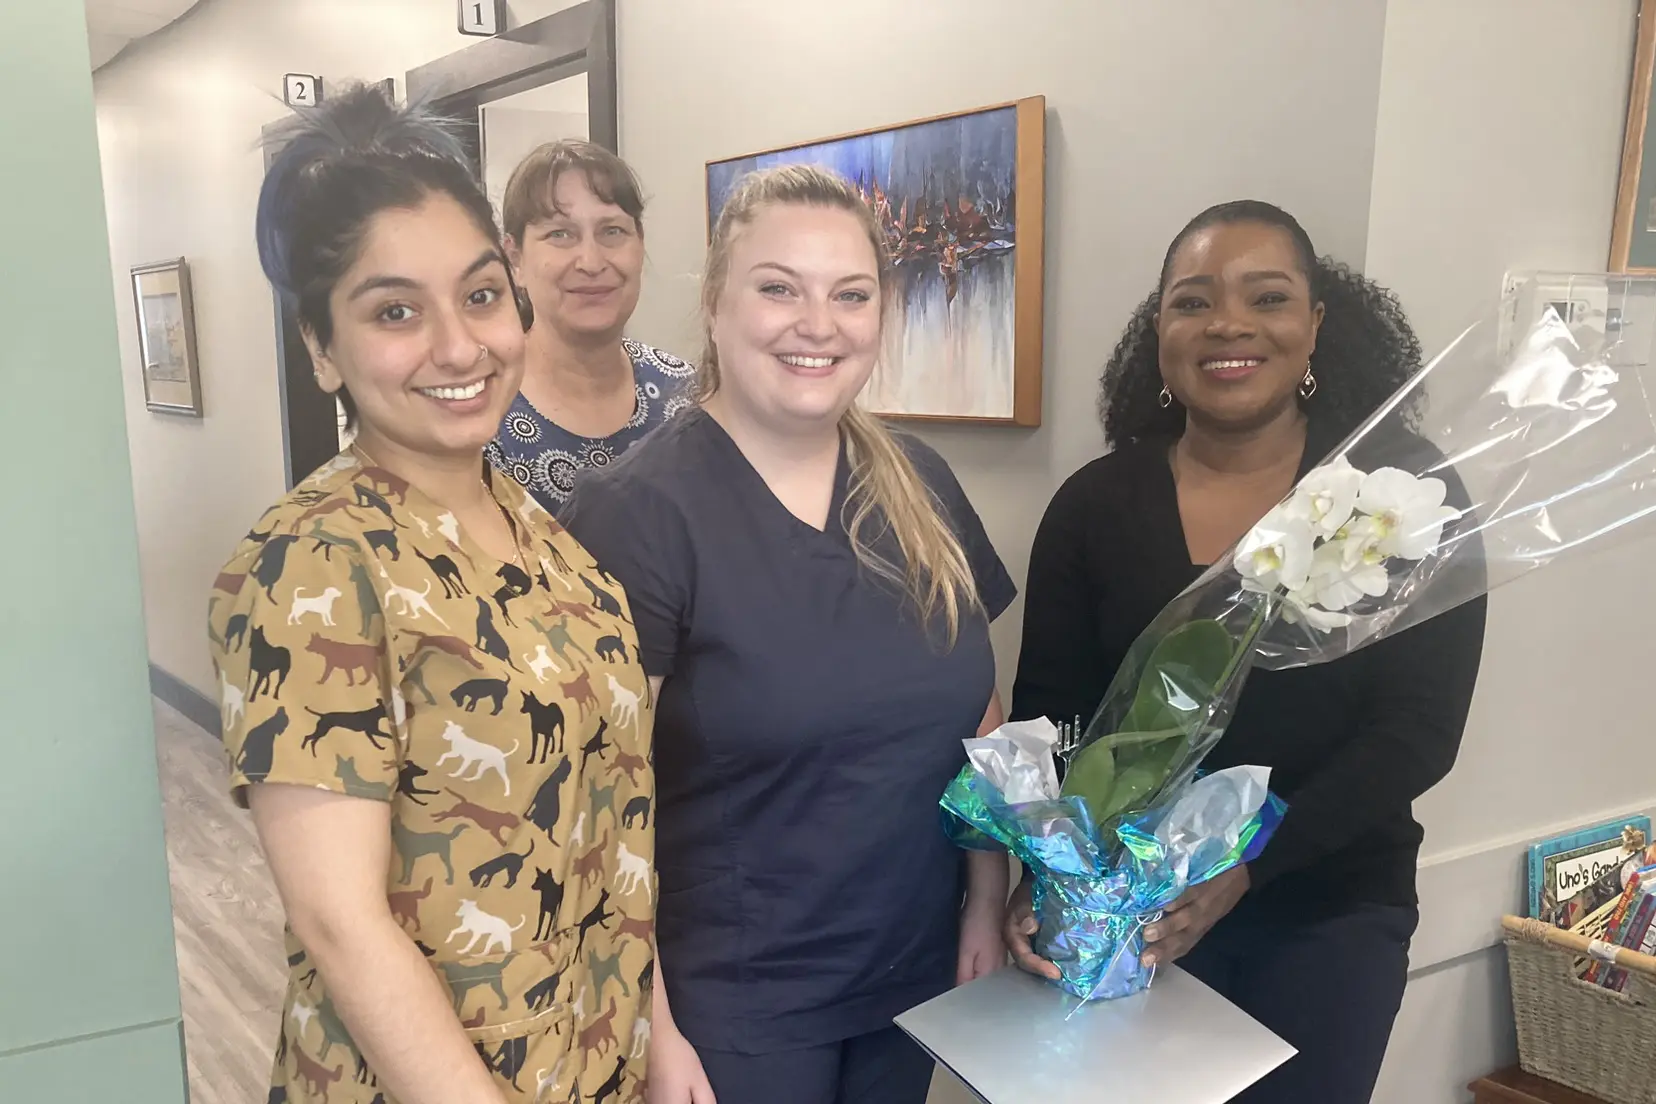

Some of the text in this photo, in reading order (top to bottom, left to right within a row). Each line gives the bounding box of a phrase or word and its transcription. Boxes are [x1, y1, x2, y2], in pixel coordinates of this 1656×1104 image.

[473, 3, 484, 26] 1
[295, 81, 307, 100] 2
[1559, 863, 1589, 890] Uno's
